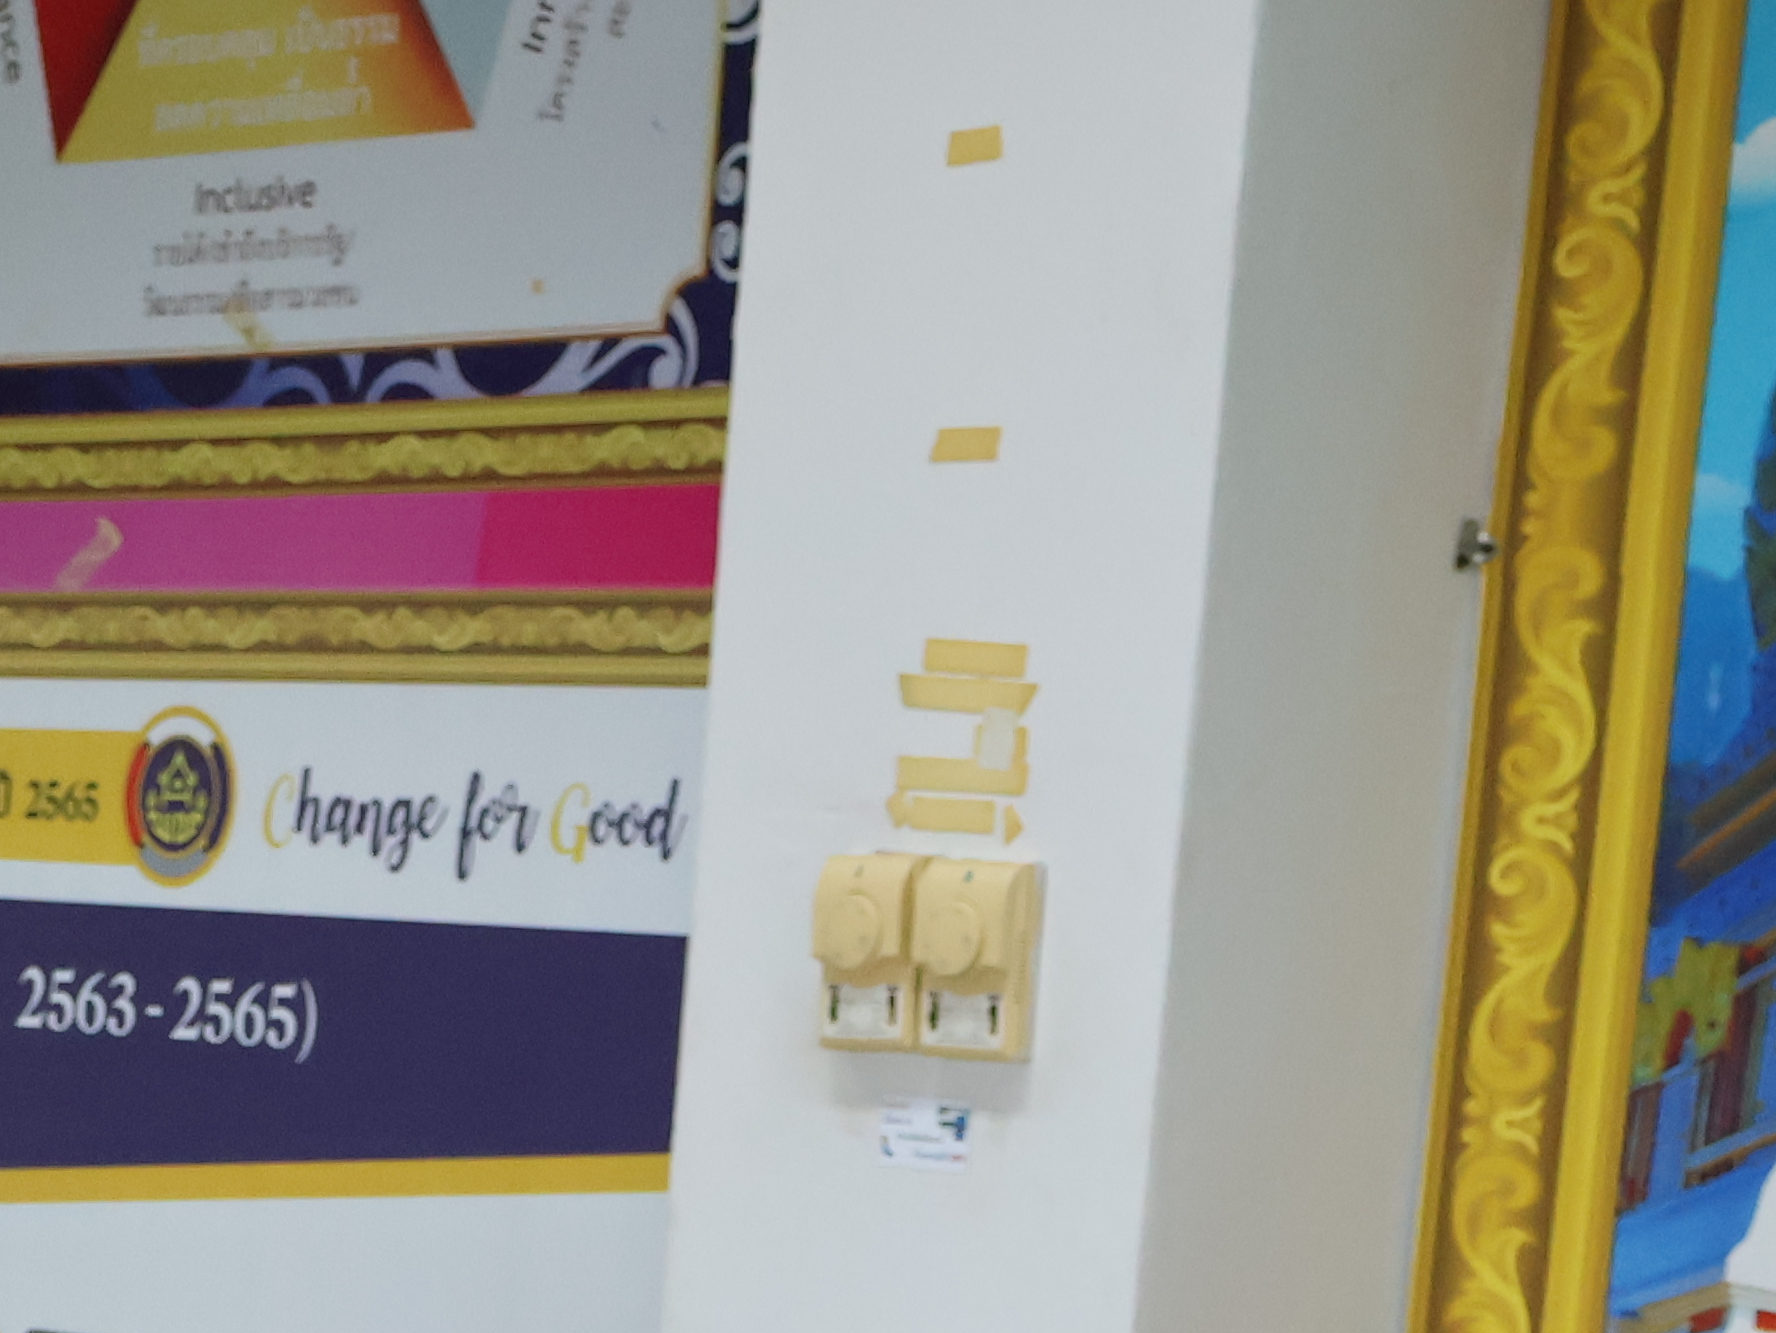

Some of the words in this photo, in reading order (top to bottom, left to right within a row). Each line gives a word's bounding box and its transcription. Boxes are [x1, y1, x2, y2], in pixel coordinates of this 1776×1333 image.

[194, 176, 317, 215] Inclusive
[25, 780, 100, 820] 2565
[263, 767, 439, 872] Change
[456, 772, 532, 880] for
[549, 779, 681, 862] Good
